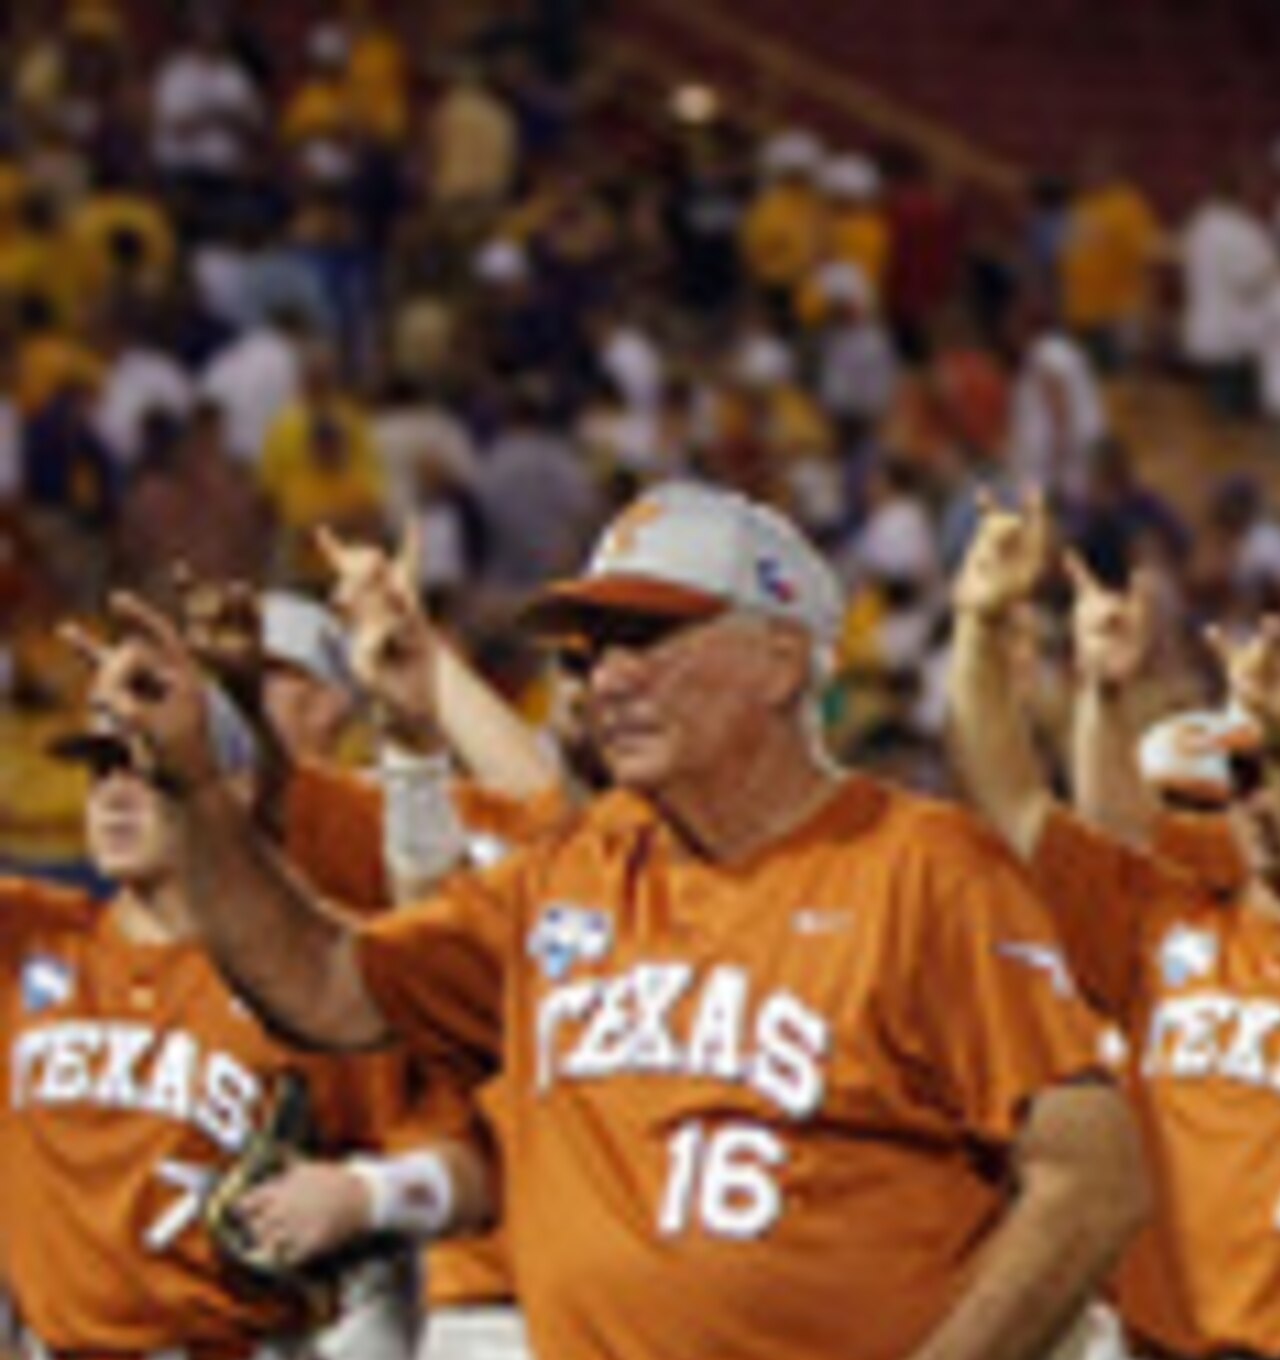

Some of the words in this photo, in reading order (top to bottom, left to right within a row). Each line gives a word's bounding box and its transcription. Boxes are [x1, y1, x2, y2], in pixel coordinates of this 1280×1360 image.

[10, 1018, 263, 1152] TEXAS
[140, 1156, 212, 1250] 7
[656, 1116, 786, 1239] 16
